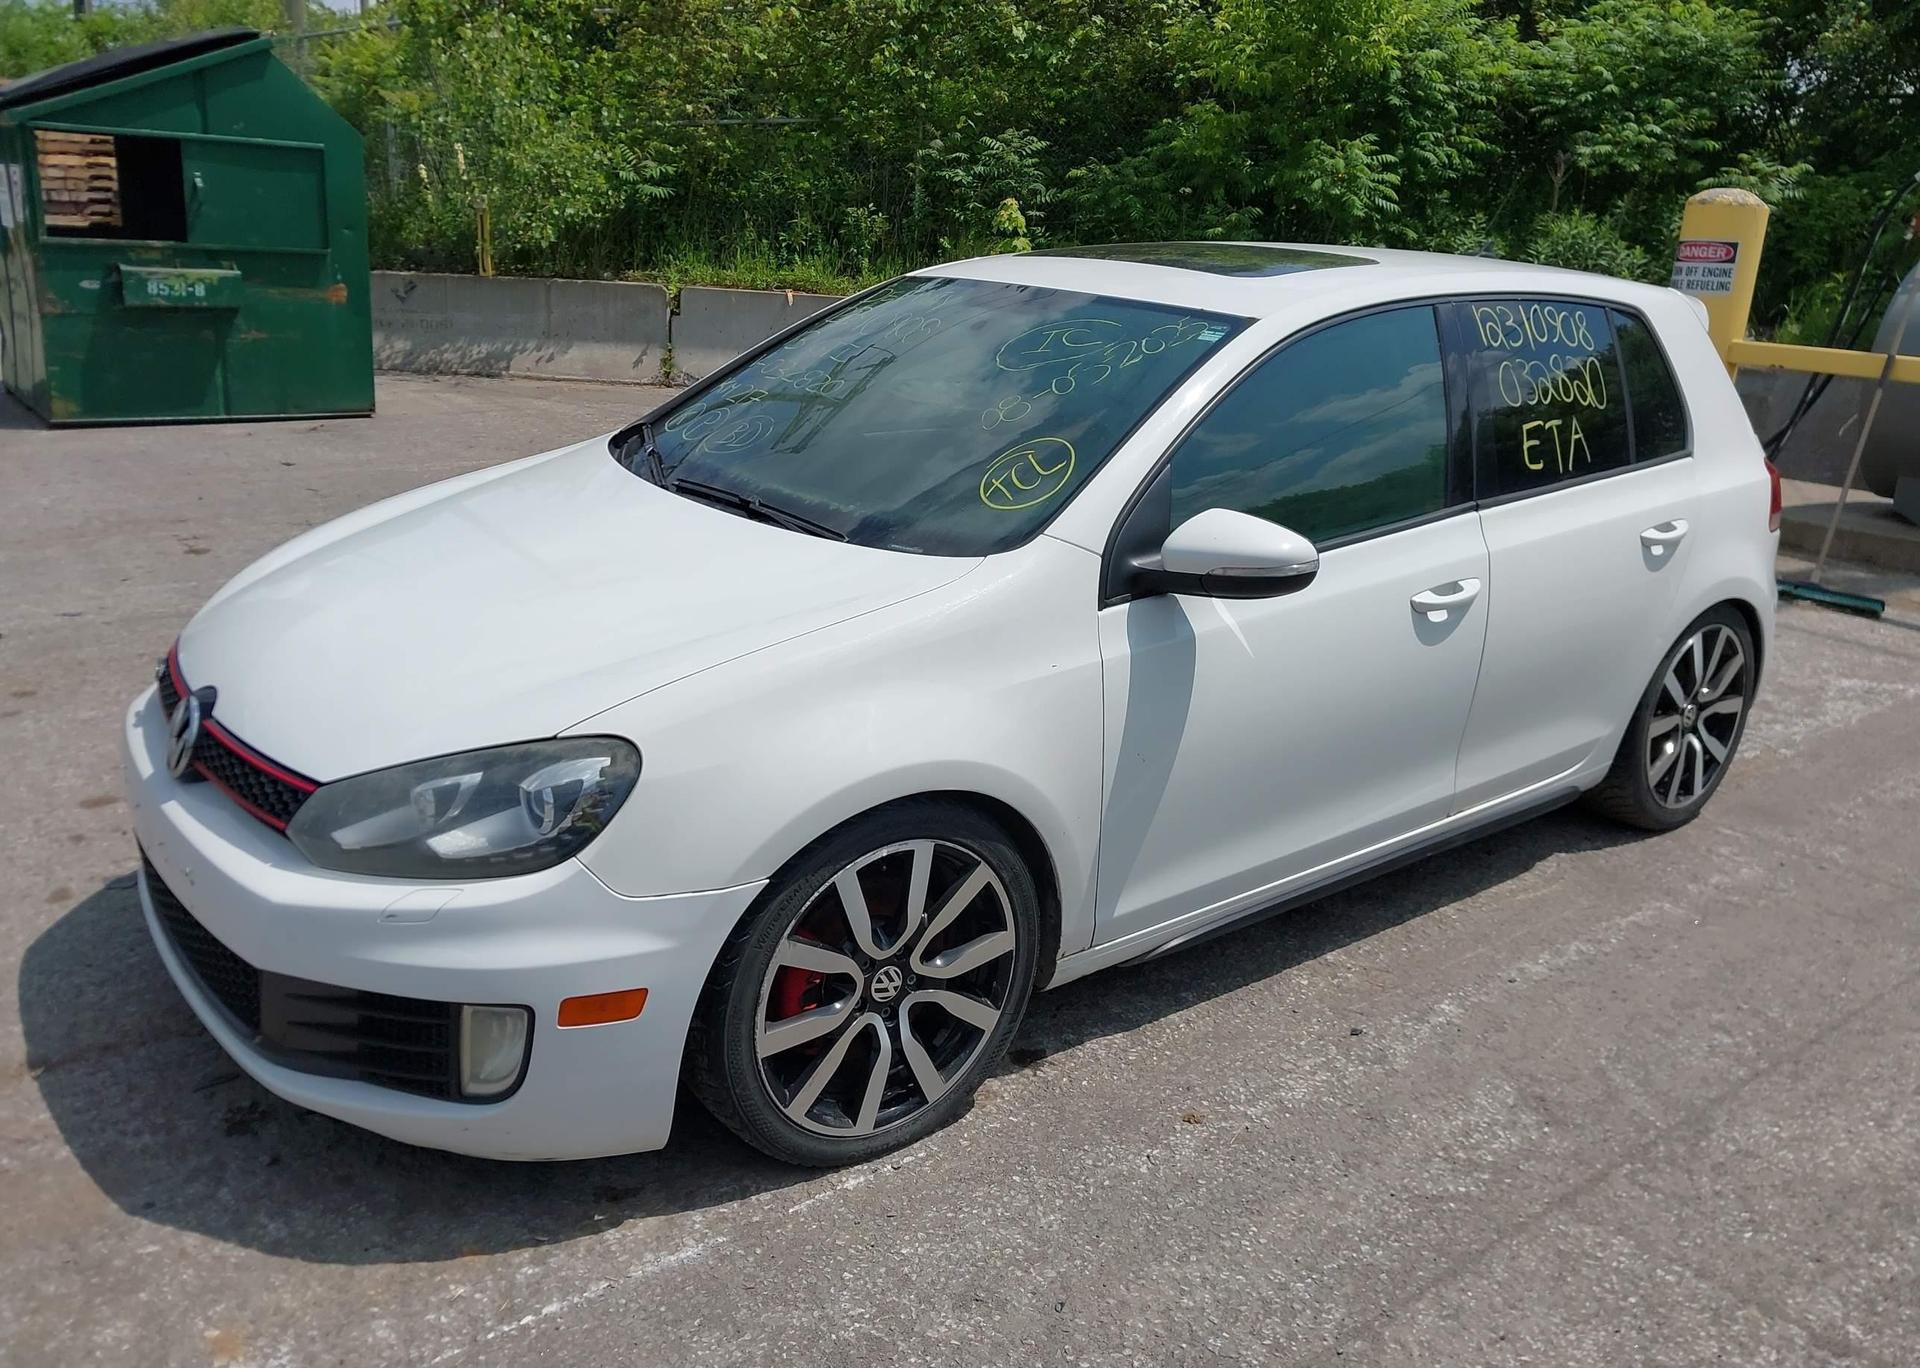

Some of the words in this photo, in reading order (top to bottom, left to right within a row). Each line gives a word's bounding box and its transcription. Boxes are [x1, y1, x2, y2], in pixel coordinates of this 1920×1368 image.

[1685, 279, 1732, 292] REFUELING
[1701, 266, 1735, 279] ENGINE
[1472, 304, 1595, 351] 12310908
[1499, 354, 1607, 409] 032820
[1521, 415, 1592, 474] ETA
